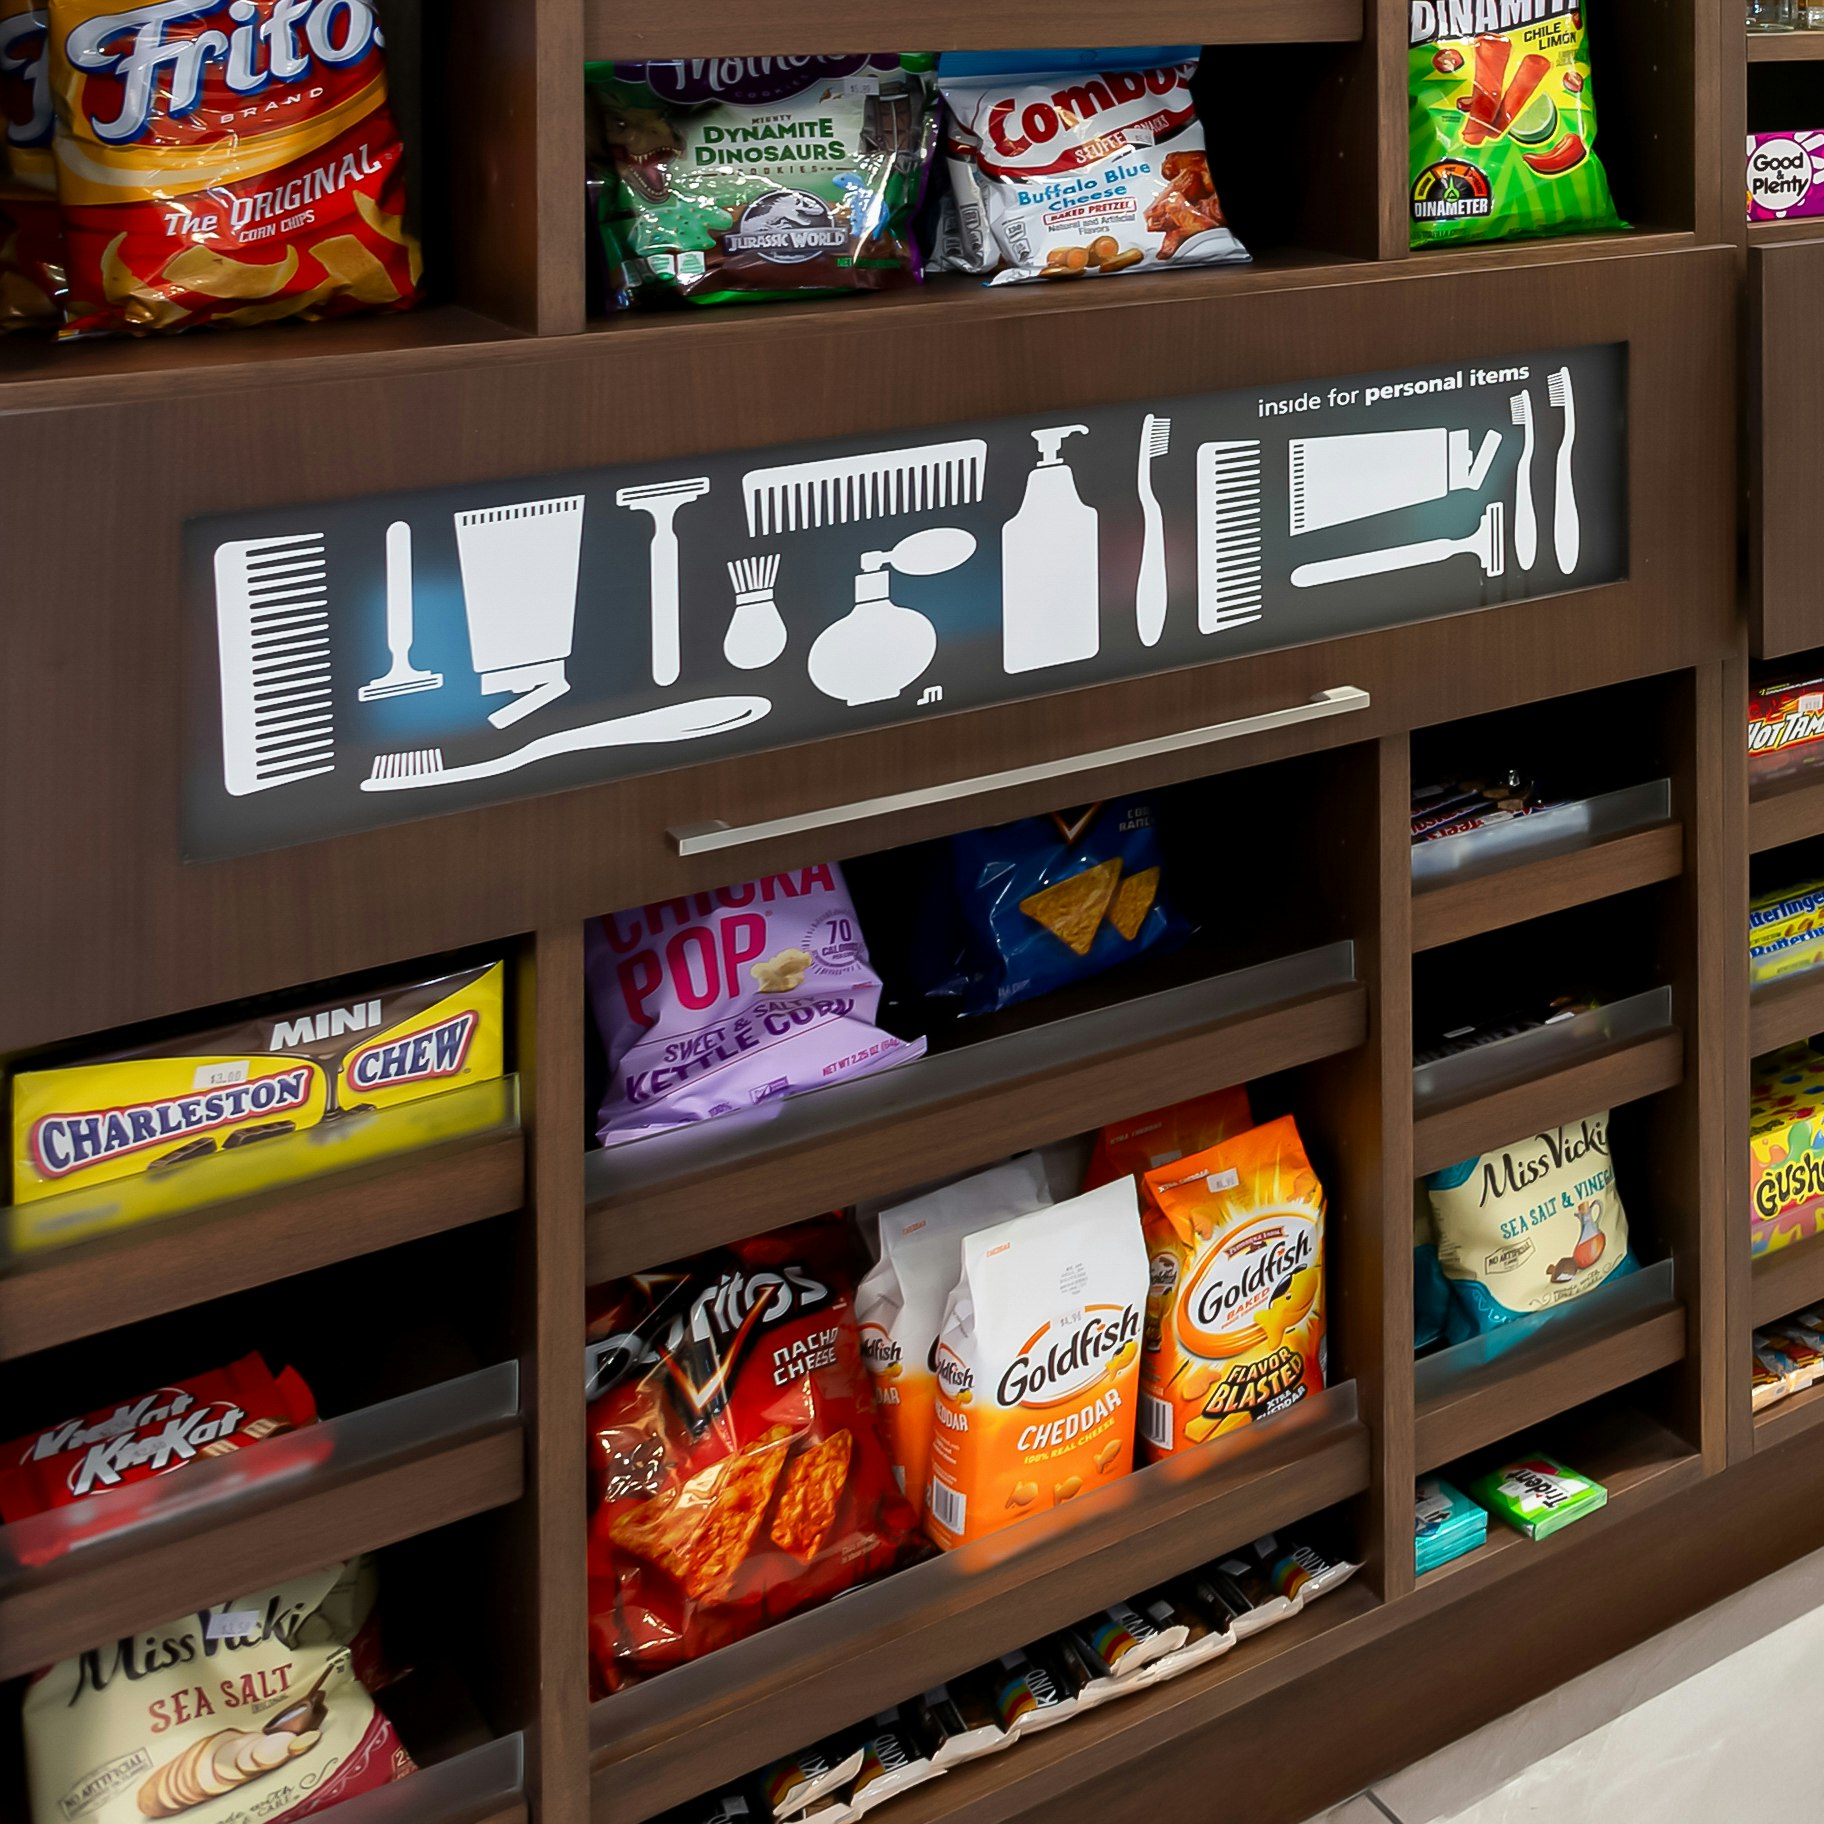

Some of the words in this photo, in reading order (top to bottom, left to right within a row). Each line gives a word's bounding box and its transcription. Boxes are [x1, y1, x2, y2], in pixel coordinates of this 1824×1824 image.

[1523, 22, 1562, 43] CHILE
[1538, 27, 1577, 51] LIMÓN
[220, 87, 324, 124] BRAND
[703, 117, 834, 144] DYNAMITE
[695, 141, 845, 166] DINOSAURS
[1753, 152, 1804, 173] Good
[164, 213, 218, 237] The
[230, 142, 383, 229] ORIGINAL
[1017, 178, 1098, 207] Buffalo
[1104, 161, 1151, 184] Blue
[1753, 175, 1809, 197] Plenty
[1776, 171, 1784, 181] &
[1048, 185, 1127, 212] Cheese
[1050, 207, 1086, 222] BAKED
[1088, 200, 1130, 215] PRETZEL
[1415, 198, 1488, 217] DINAMETER
[239, 223, 276, 244] CORN
[280, 209, 316, 233] CHIPS
[728, 233, 789, 252] JURASSIC
[790, 230, 846, 249] WORLD
[1258, 393, 1322, 418] inside
[1327, 387, 1360, 408] for
[1364, 370, 1463, 407] personal
[1469, 365, 1530, 387] items
[827, 918, 853, 945] 70
[616, 912, 767, 1030] POP
[269, 998, 382, 1052] MINI
[663, 1027, 727, 1063] SWEET
[625, 1031, 760, 1105] KETTLE
[42, 1072, 306, 1173] CHARLESTON
[356, 1018, 470, 1085] CHEW
[1479, 1151, 1553, 1208] Miss
[1499, 1214, 1530, 1240] SEA
[1531, 1197, 1558, 1227] SALT
[1560, 1189, 1574, 1210] &
[1198, 1229, 1311, 1325] Goldfish
[1225, 1286, 1271, 1321] BAKED
[773, 1326, 840, 1367] NACHO
[996, 1303, 1140, 1407] Goldfish
[1227, 1346, 1292, 1384] FLAVOR
[772, 1346, 837, 1387] CHEESE
[1206, 1353, 1305, 1414] BLASTED
[1266, 1389, 1293, 1411] XTRA
[1016, 1388, 1123, 1452] CHEDDAR
[1051, 1442, 1077, 1459] REAL
[1078, 1418, 1116, 1446] CHEESE
[1505, 1467, 1567, 1509] Trident
[149, 1686, 216, 1735] SEA
[223, 1663, 294, 1710] SALT
